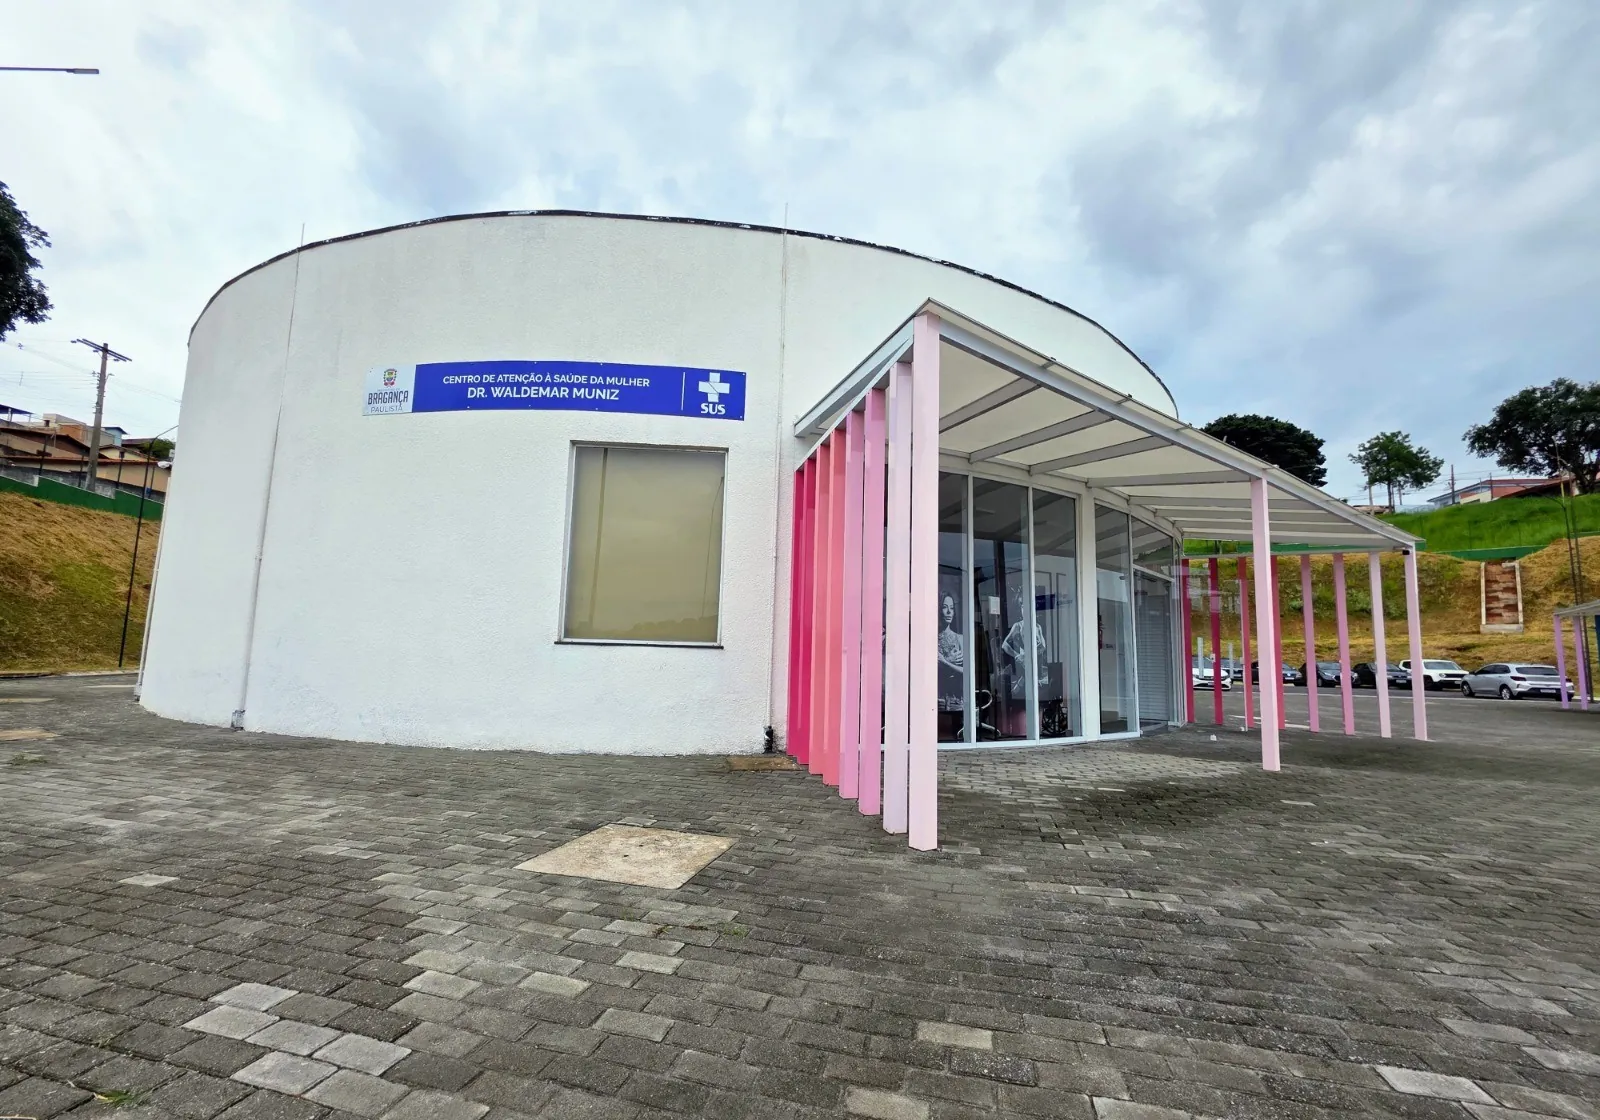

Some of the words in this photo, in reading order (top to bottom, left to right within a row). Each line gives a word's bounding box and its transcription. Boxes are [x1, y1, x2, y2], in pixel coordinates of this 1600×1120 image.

[443, 375, 480, 384] CENTRO
[482, 374, 495, 383] DE
[497, 372, 543, 384] ATENÇÃO
[544, 372, 552, 383] À
[554, 373, 588, 384] SAÚDE
[590, 375, 604, 385] DA
[606, 376, 650, 387] MULHER
[368, 390, 409, 407] BRAGANÇA
[467, 387, 488, 398] DR.
[491, 386, 569, 398] WALDEMAR
[573, 387, 620, 400] MUNIZ
[370, 405, 403, 413] PAULISTA
[700, 403, 726, 415] SUS
